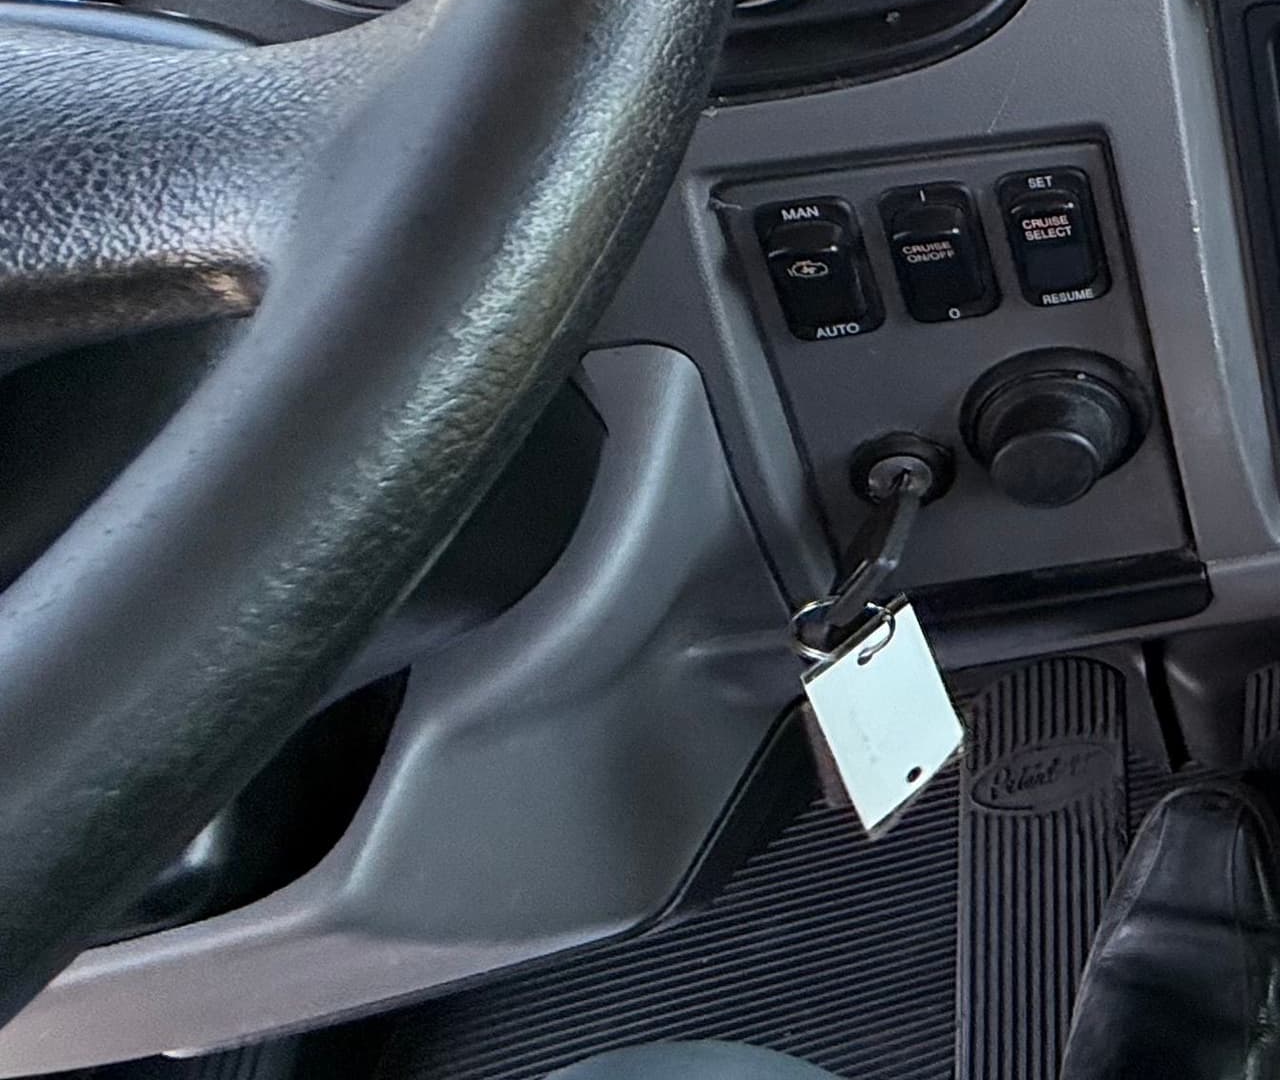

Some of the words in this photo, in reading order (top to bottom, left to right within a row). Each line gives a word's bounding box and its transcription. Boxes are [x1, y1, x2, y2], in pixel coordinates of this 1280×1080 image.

[1028, 175, 1053, 190] SET
[781, 205, 820, 220] MAN
[1022, 214, 1069, 230] CRUISE
[1025, 225, 1073, 241] SELECT
[902, 241, 952, 255] CRUISE
[907, 249, 955, 264] ON/OFF
[1042, 288, 1094, 305] RESUME
[816, 322, 860, 339] AUTO
